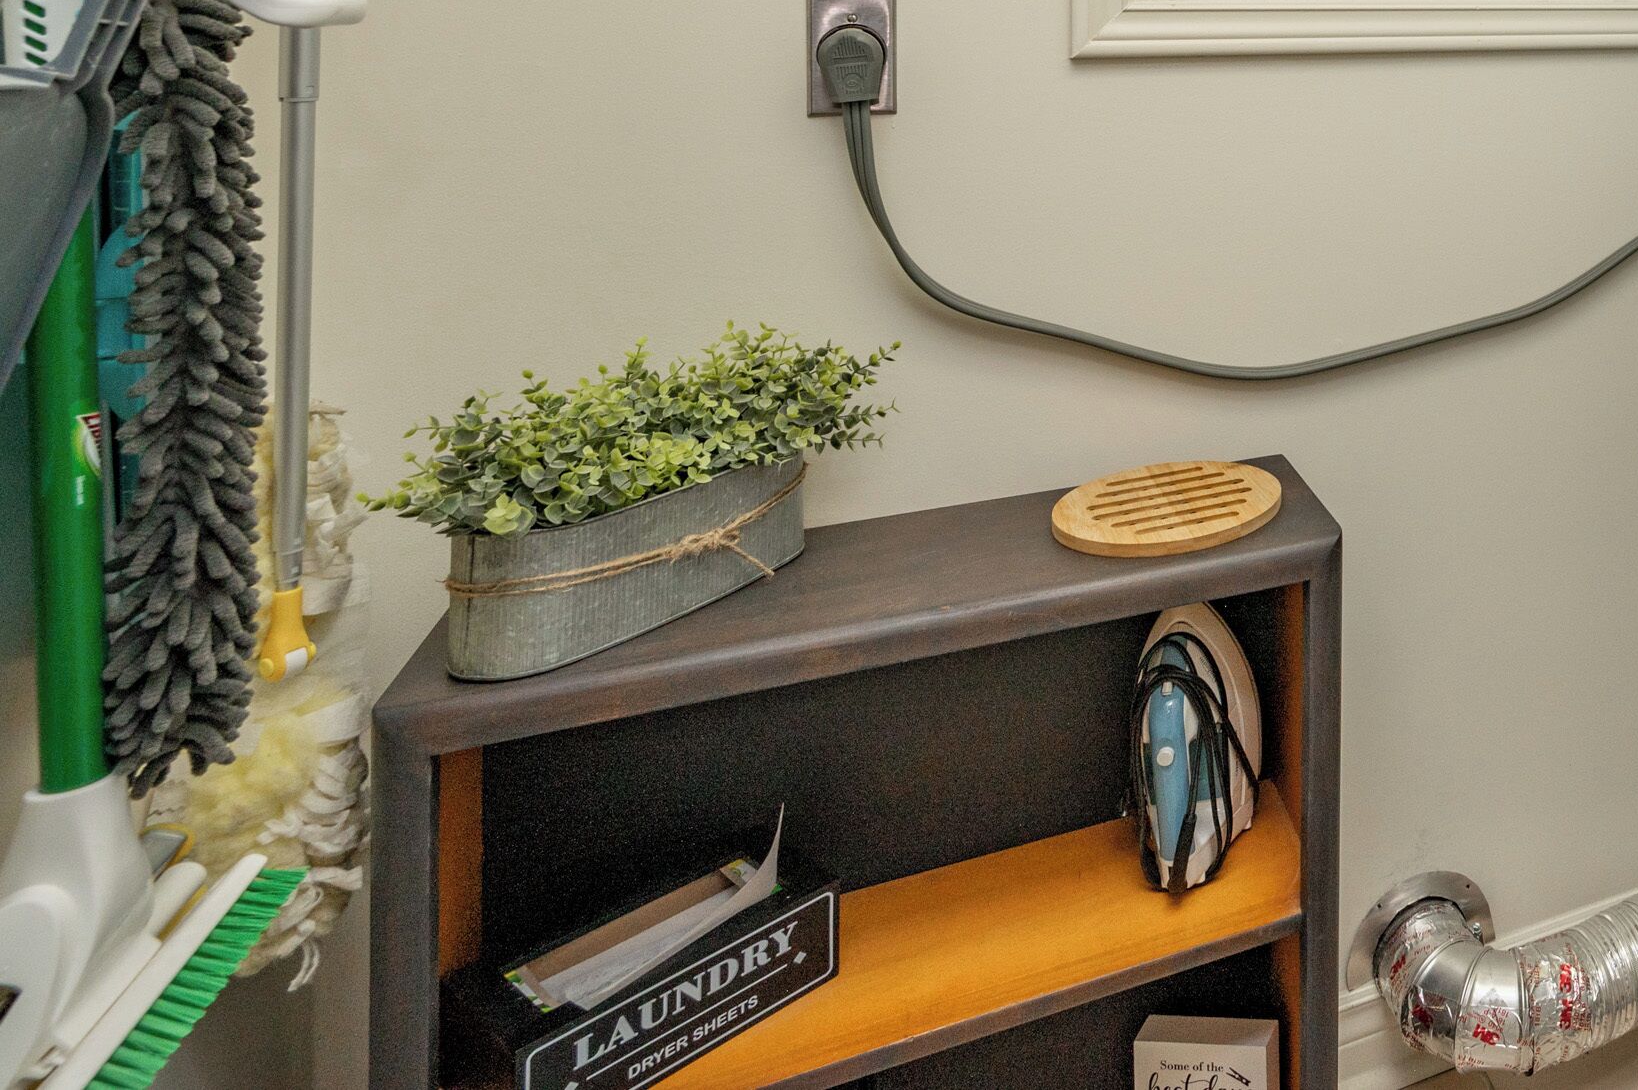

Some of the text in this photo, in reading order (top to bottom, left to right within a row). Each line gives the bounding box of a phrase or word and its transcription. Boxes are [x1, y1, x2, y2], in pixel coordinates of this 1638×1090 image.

[573, 921, 798, 1071] LAUNDRY
[628, 995, 758, 1079] DRYER SHEETS
[1160, 1060, 1224, 1072] Some of the
